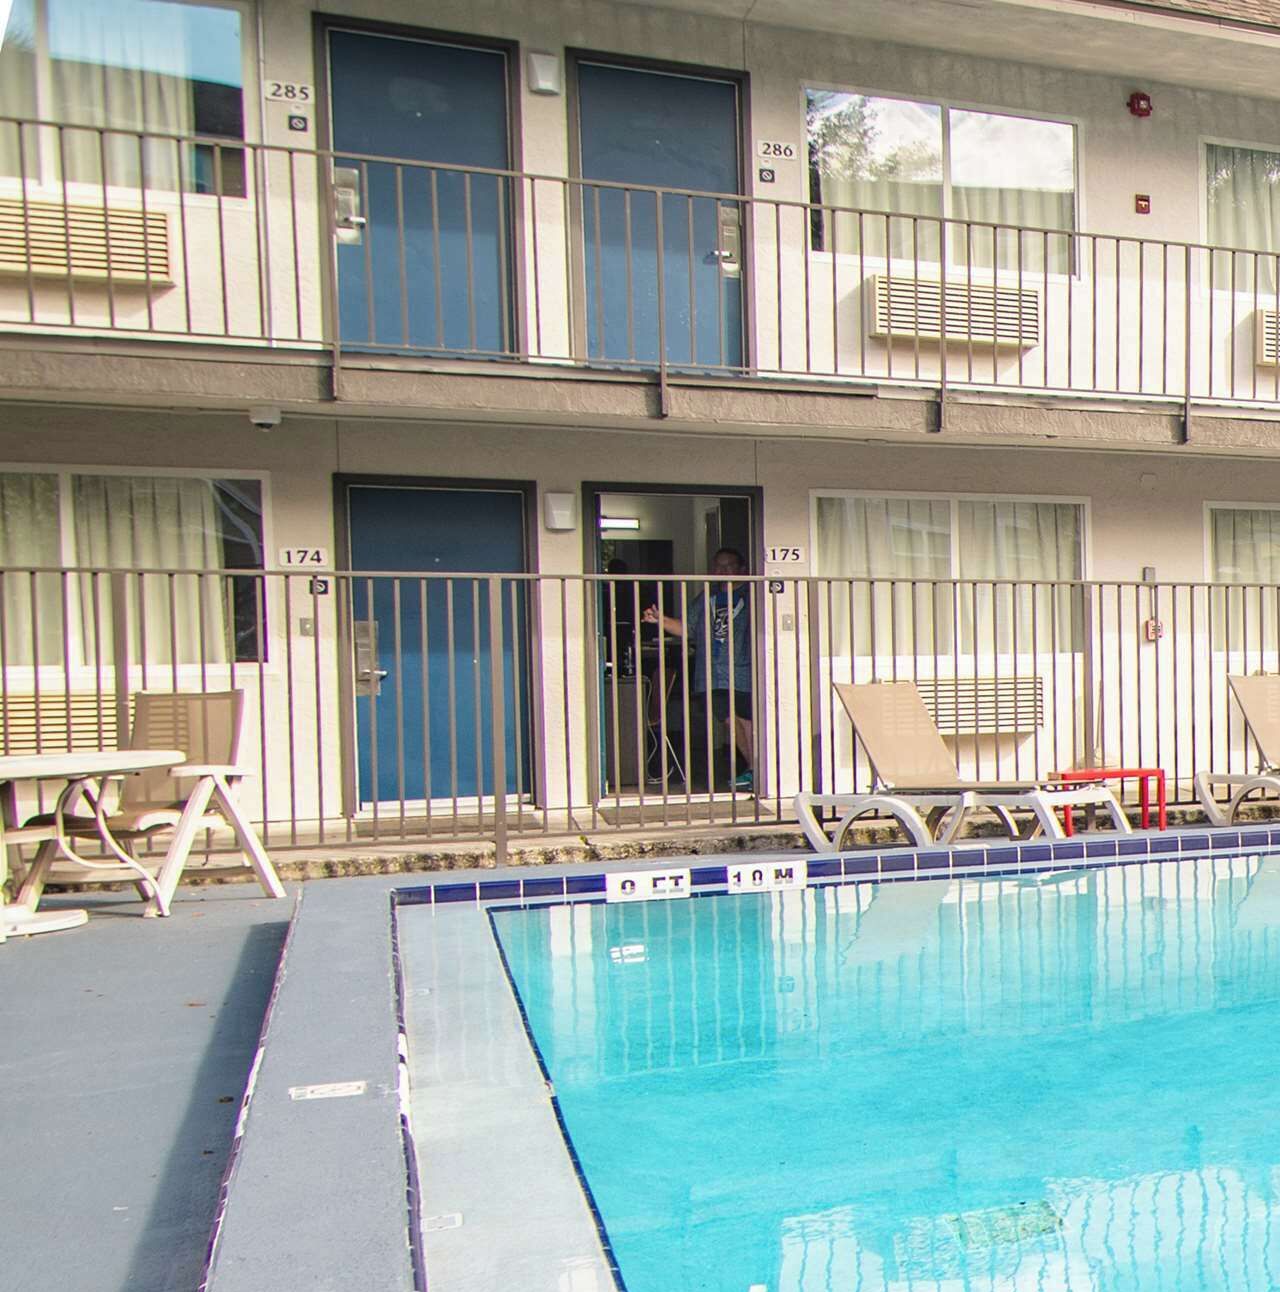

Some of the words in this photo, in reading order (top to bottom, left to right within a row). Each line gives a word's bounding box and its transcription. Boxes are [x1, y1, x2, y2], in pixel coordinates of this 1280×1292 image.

[271, 82, 309, 101] 285
[762, 142, 793, 157] 286
[285, 549, 323, 564] 174
[770, 548, 800, 561] 175
